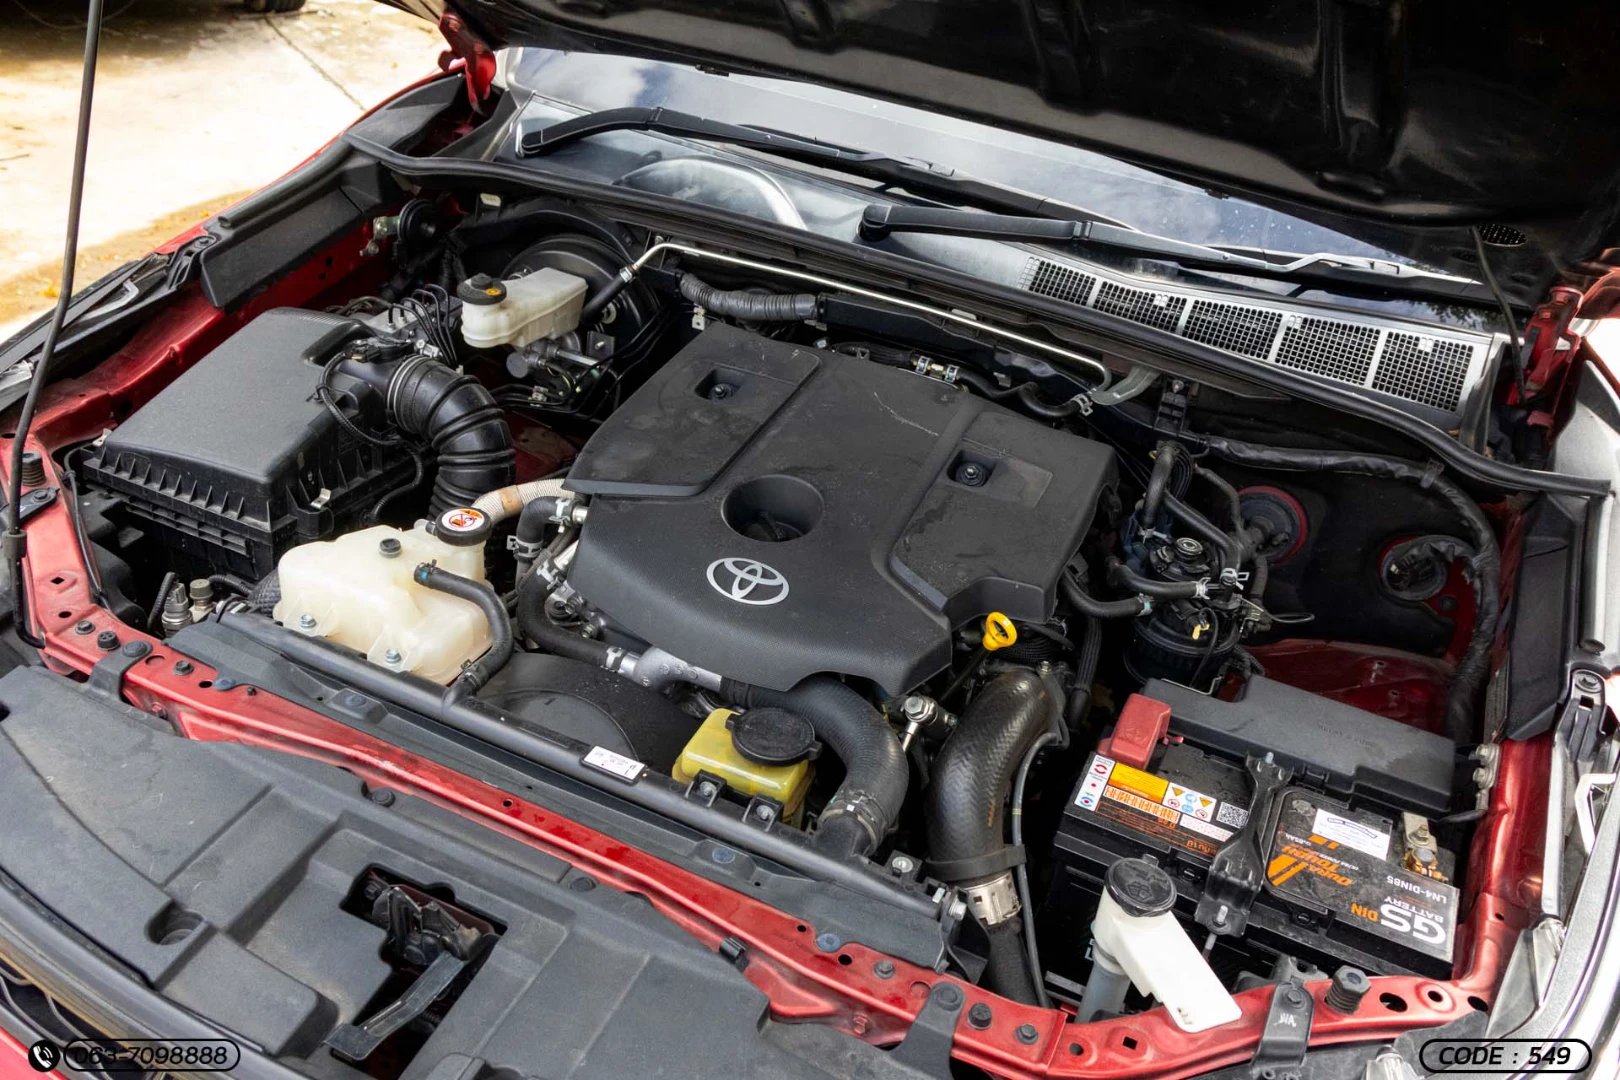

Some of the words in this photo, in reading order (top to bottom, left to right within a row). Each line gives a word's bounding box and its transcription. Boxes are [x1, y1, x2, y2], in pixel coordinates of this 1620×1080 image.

[1309, 863, 1355, 887] DURA
[1386, 875, 1447, 904] LN4-DIN85
[1351, 903, 1379, 922] DIN
[1384, 896, 1444, 923] BATTERY
[1380, 903, 1446, 945] GS
